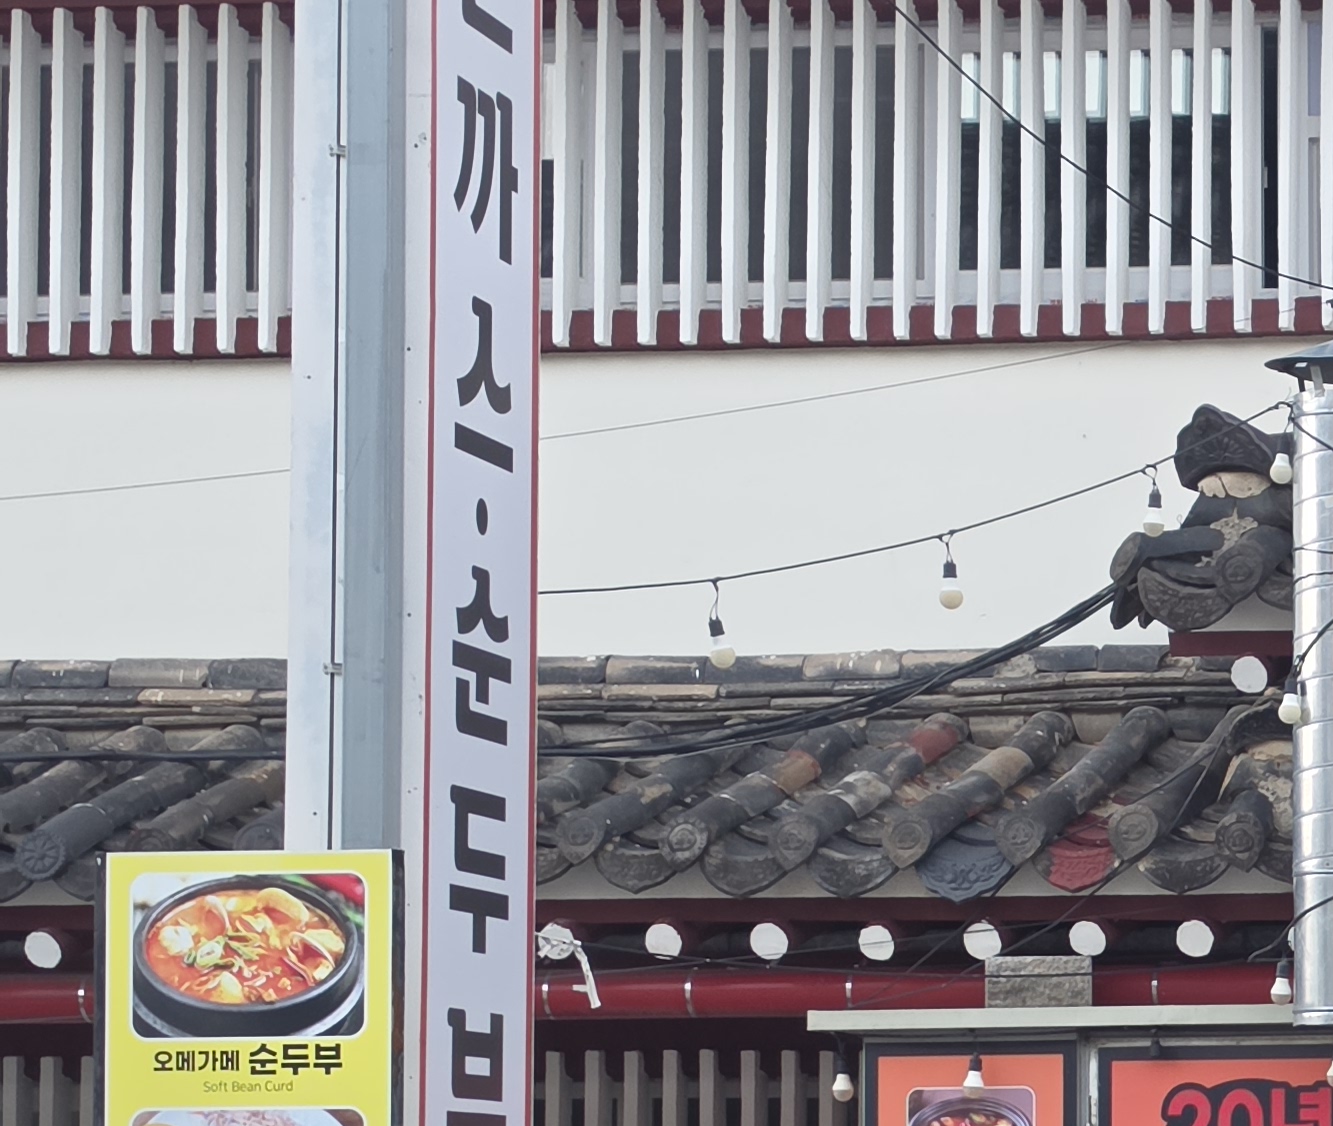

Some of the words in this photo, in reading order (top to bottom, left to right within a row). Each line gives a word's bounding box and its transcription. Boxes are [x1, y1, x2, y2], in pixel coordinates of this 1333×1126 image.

[153, 1049, 240, 1072] 오메가메
[248, 1043, 343, 1076] 순두부
[202, 1080, 229, 1093] Soft
[231, 1080, 262, 1093] Bean
[264, 1080, 294, 1093] Curd
